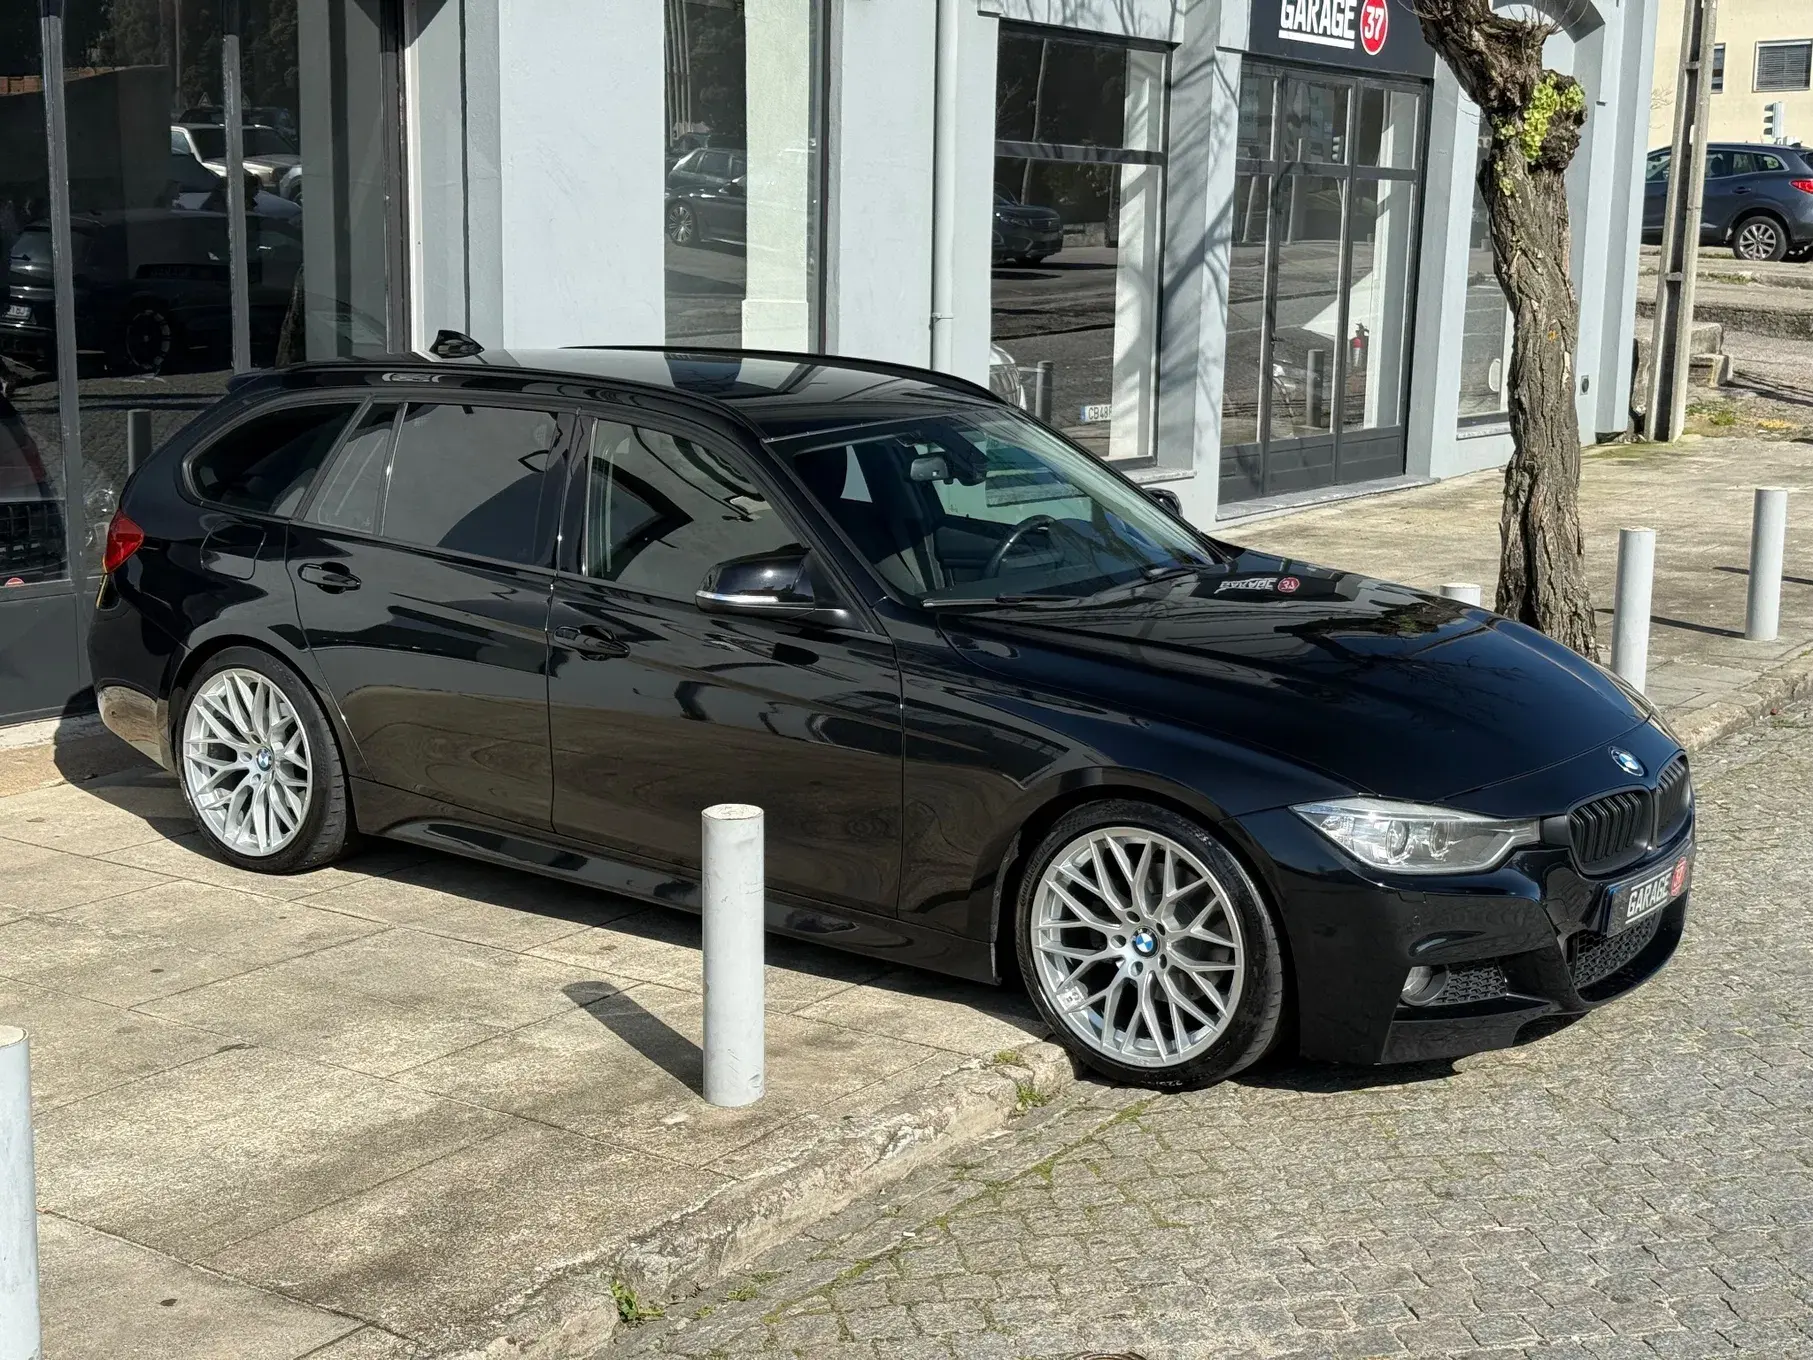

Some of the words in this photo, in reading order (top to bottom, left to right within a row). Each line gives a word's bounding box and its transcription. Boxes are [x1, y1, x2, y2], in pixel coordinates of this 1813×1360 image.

[1280, 0, 1357, 40] GARAGE
[1364, 7, 1384, 40] 37
[1627, 872, 1672, 917] GARAGE
